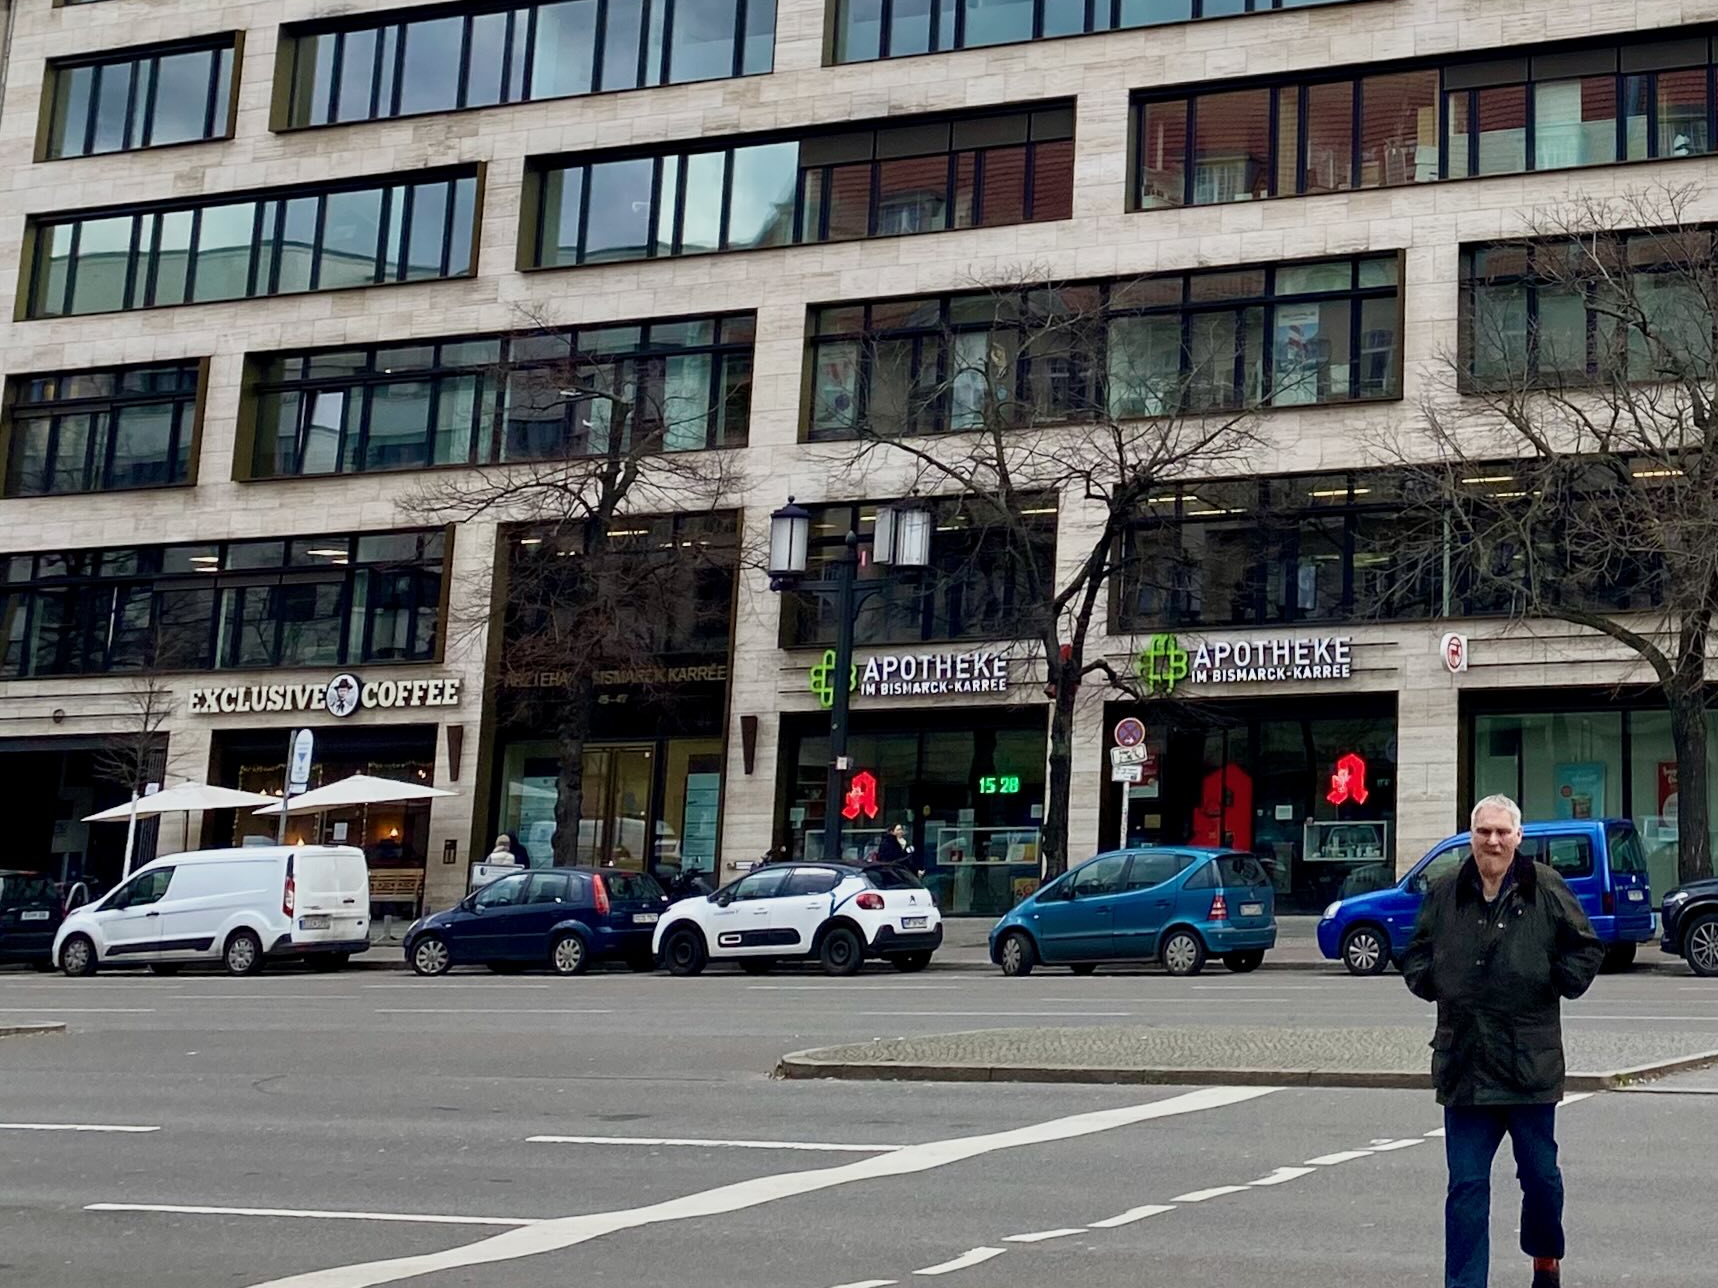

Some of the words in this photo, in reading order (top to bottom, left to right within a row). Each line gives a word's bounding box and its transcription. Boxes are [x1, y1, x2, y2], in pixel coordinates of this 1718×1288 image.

[862, 652, 1008, 682] APOTHEKE
[1193, 636, 1352, 669] APOTHEKE
[860, 683, 876, 696] IM
[880, 678, 1007, 696] BISMARCK-KARREE
[1191, 670, 1208, 684] IM
[1213, 663, 1351, 683] BISMARCK-KARREE
[187, 683, 328, 714] EXCLUSIVE
[361, 678, 461, 709] COFFEE
